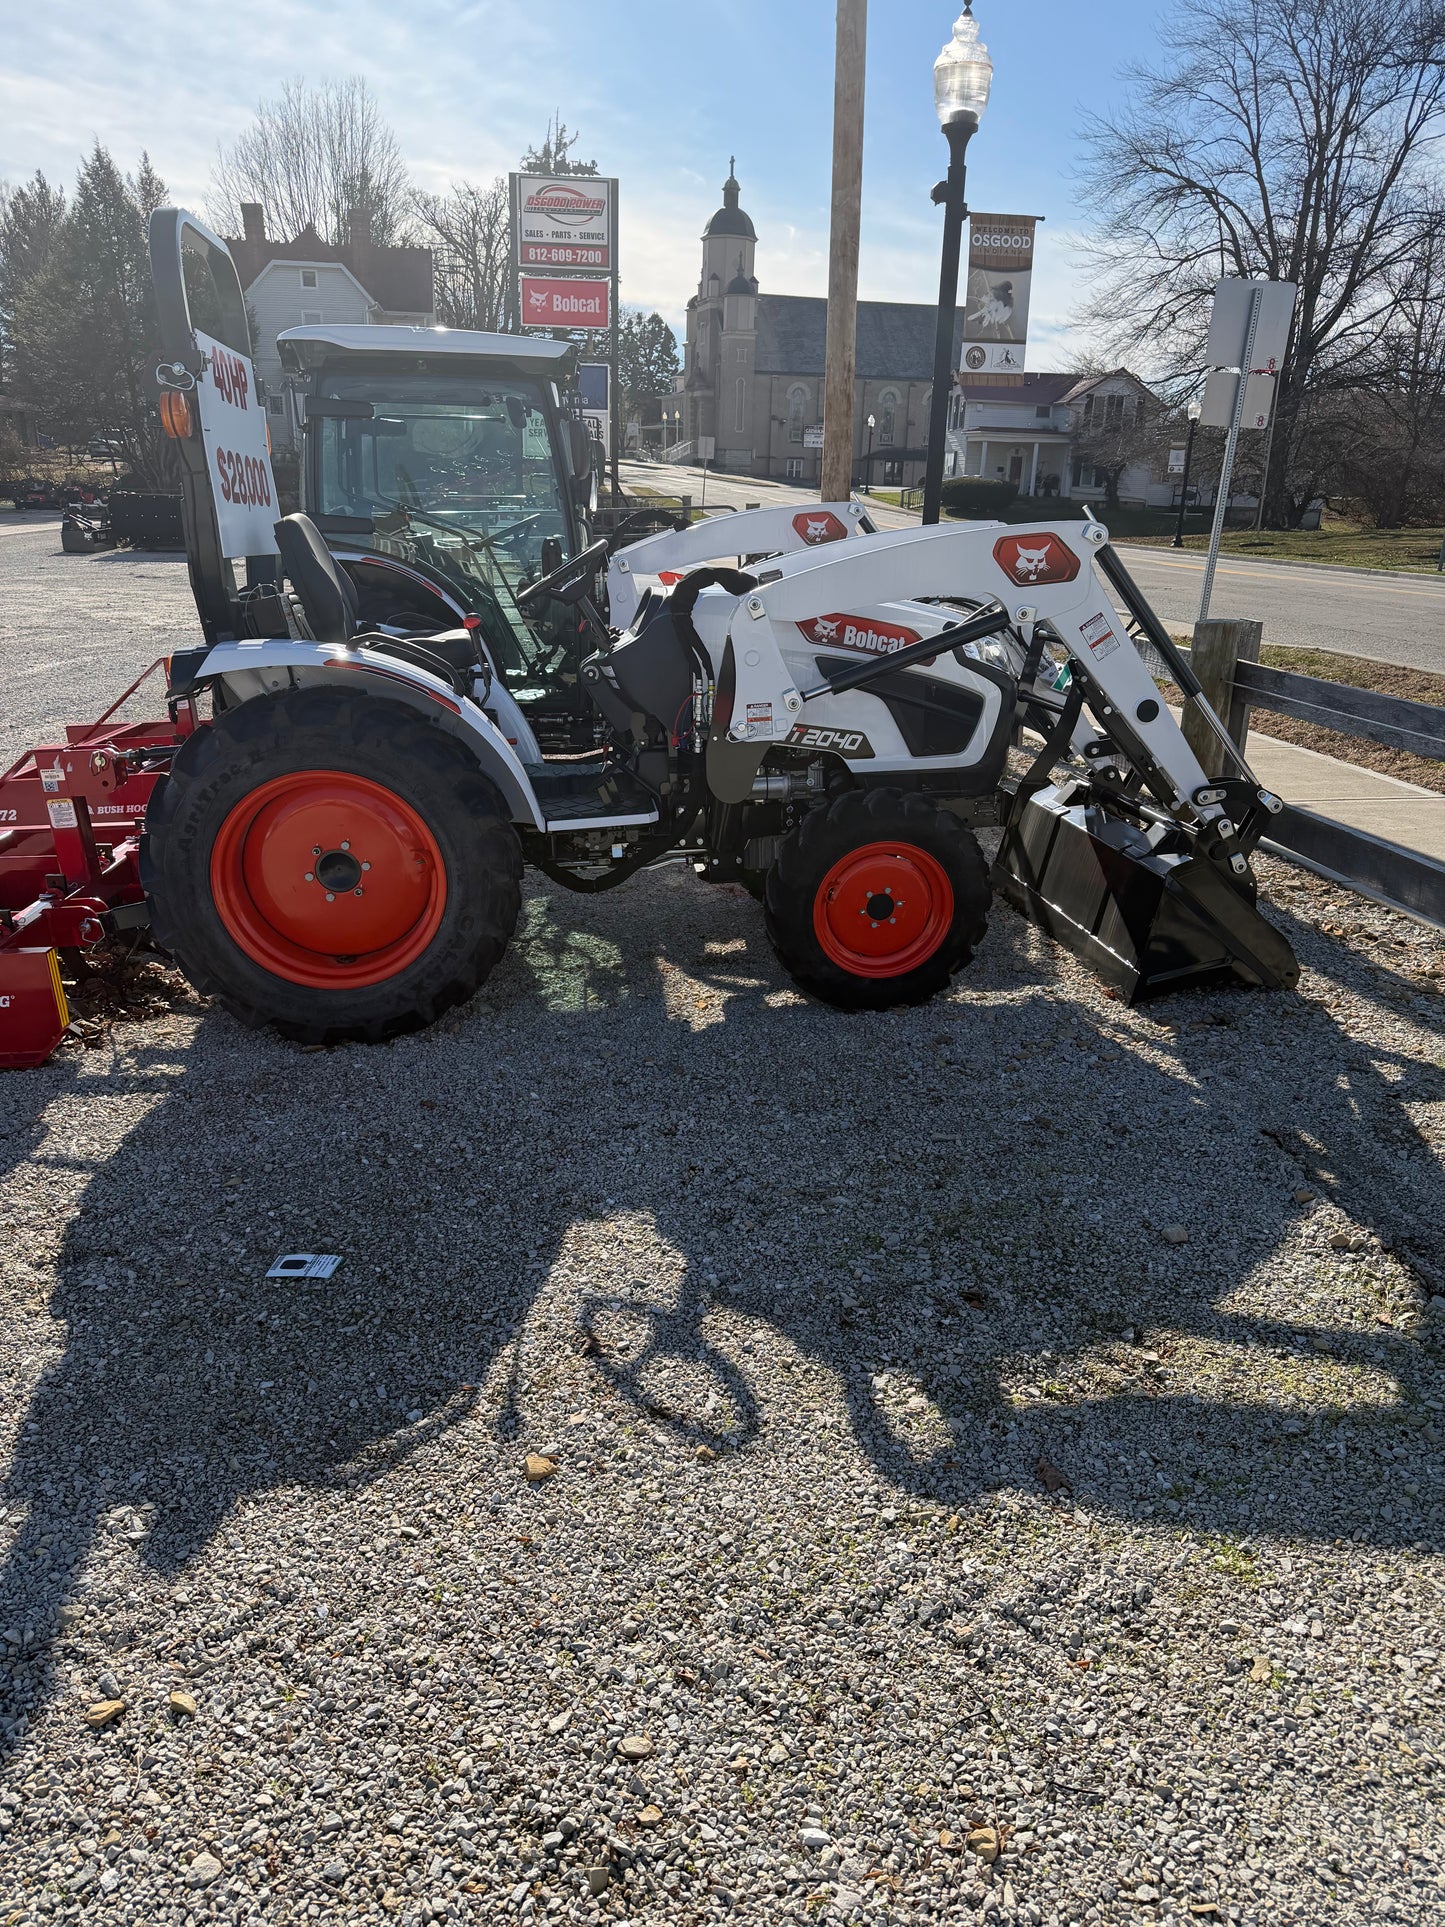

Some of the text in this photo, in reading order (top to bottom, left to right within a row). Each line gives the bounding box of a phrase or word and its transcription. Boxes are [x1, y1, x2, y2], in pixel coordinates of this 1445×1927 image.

[527, 196, 604, 209] OSGOOD POWER
[524, 229, 605, 240] SALES PARTS SERVICE
[975, 226, 1016, 234] WELCOME
[972, 233, 1031, 249] OSGOOD
[528, 247, 602, 263] 812-609-7200
[552, 294, 601, 313] Bobcat
[212, 345, 248, 411] 40HP
[216, 446, 271, 512] $28,000
[843, 624, 906, 653] Bobcat
[97, 805, 125, 815] BUSH
